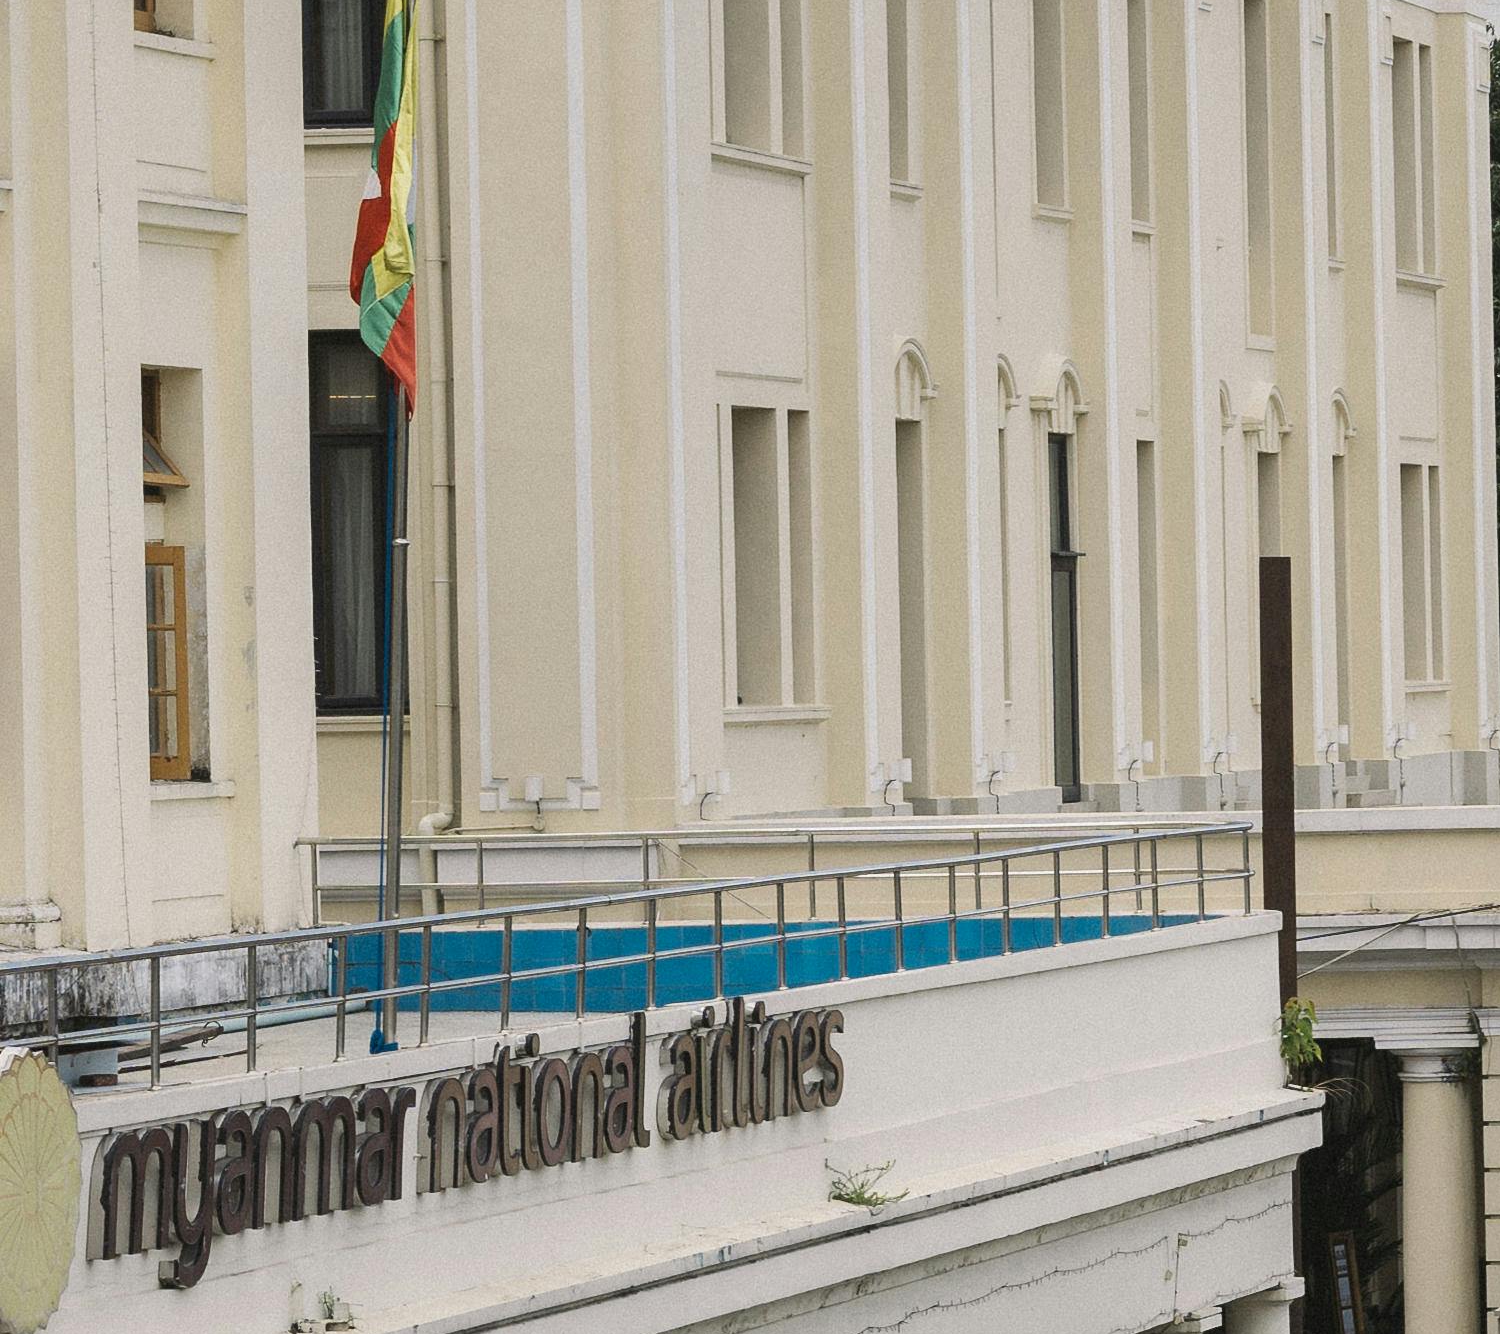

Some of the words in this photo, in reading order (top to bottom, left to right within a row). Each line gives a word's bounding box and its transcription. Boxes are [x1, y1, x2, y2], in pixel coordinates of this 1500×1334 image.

[92, 1086, 416, 1290] myanmar
[418, 1012, 651, 1194] national
[660, 996, 845, 1142] airlines
